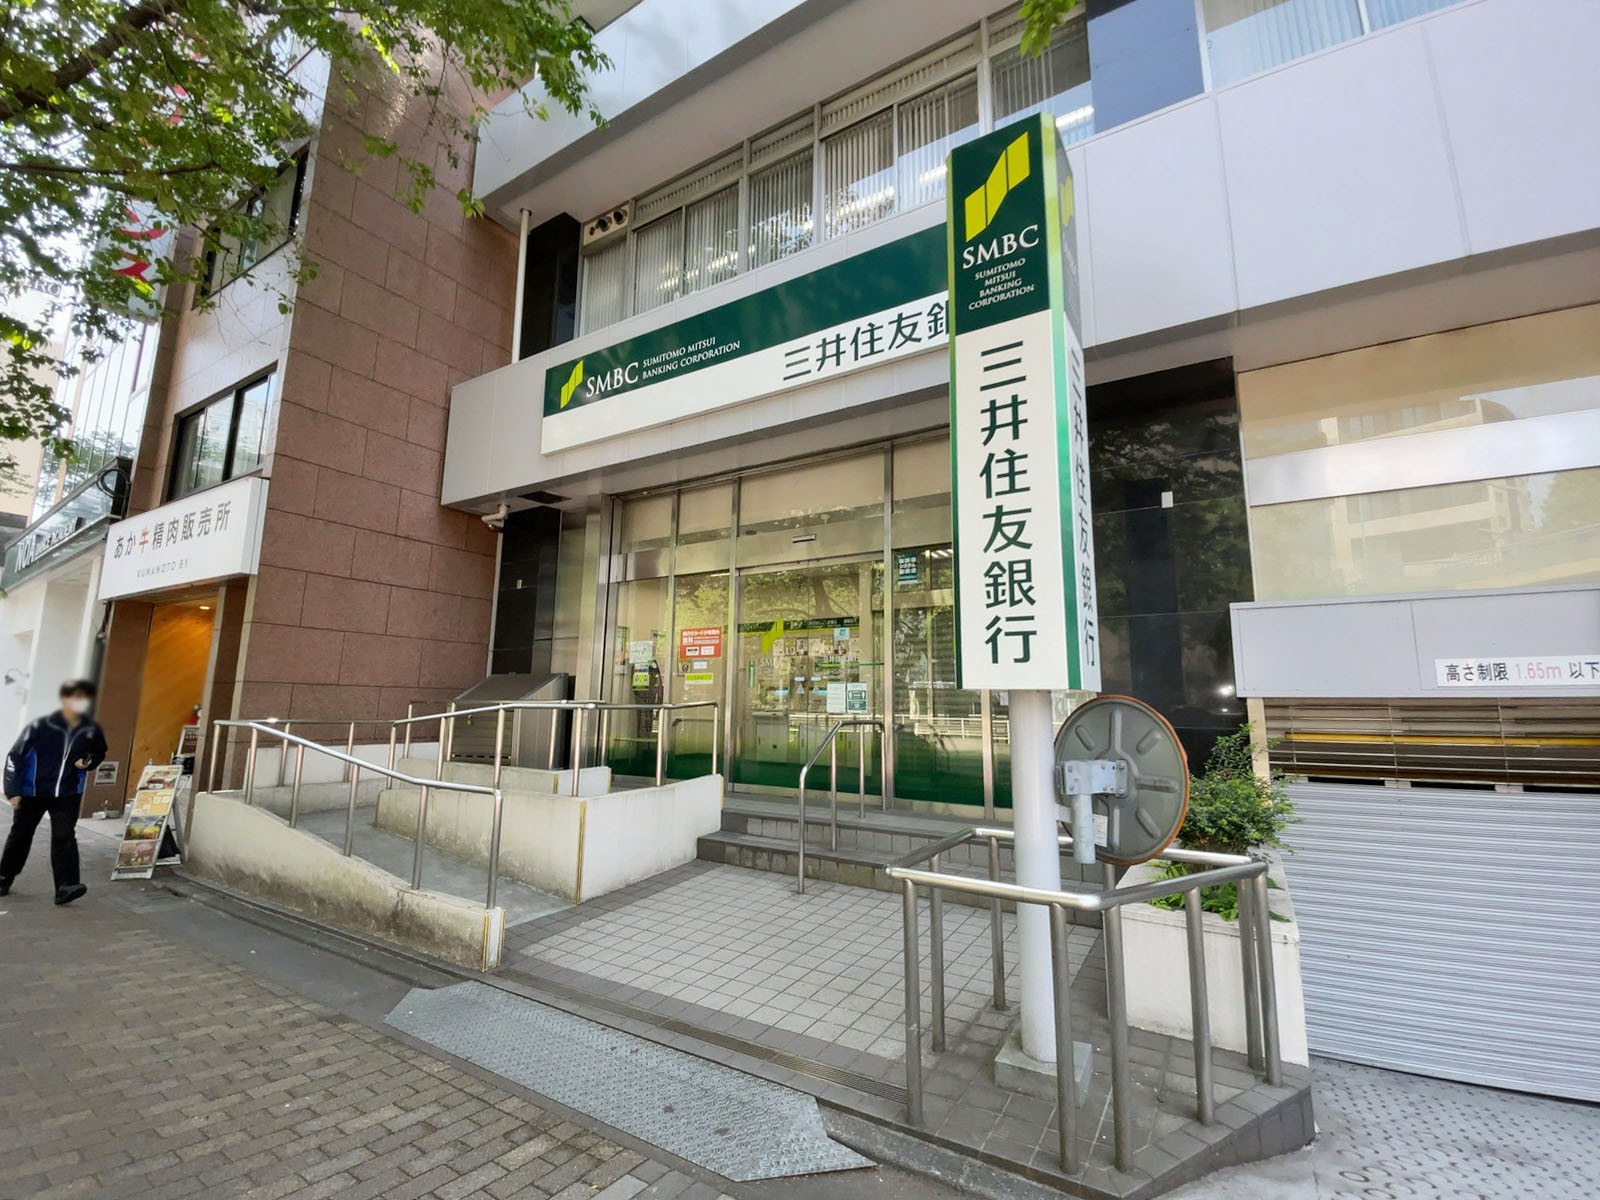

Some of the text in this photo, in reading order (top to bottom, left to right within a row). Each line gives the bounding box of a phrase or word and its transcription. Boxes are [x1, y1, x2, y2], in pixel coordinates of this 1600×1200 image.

[962, 224, 1039, 270] SMBC
[974, 257, 1026, 280] SUMITOMO
[984, 270, 1016, 286] MITSUI
[969, 284, 1035, 310] CORPORATION
[979, 278, 1022, 298] BANKING
[642, 336, 717, 367] SUMITOMO MITSUI
[642, 340, 741, 380] BANKING CORPORATION
[585, 361, 639, 398] SMBC
[980, 340, 1037, 665] 三井住友銀行
[1070, 347, 1096, 667] 三井住友銀行
[113, 500, 232, 560] あか牛精肉販売所
[136, 558, 190, 580] KUMAMOTO BY
[1445, 661, 1600, 682] 高さ制限 1.65m 以下
